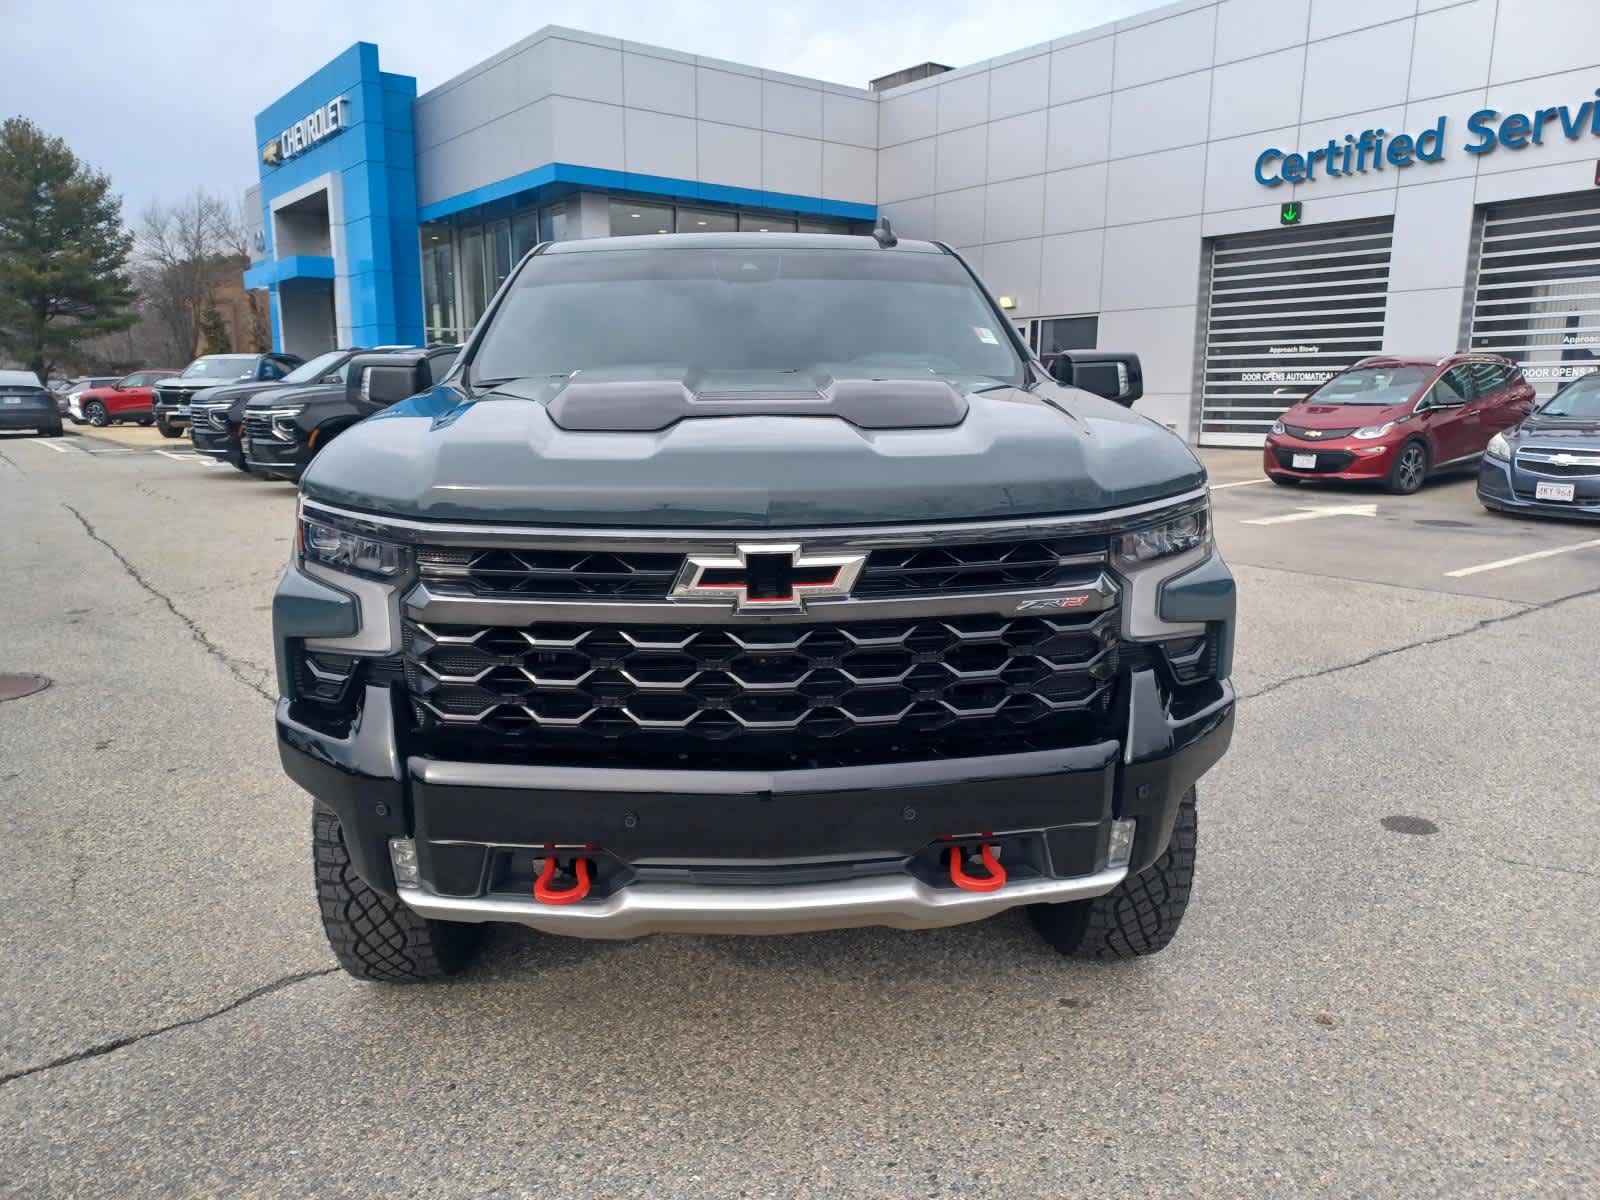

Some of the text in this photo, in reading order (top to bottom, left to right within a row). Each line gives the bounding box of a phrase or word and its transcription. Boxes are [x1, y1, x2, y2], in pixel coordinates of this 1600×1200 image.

[281, 96, 344, 158] CHEVROLET
[1254, 116, 1447, 185] Certified
[1269, 346, 1298, 354] Approach
[1241, 372, 1261, 381] DOOR
[1262, 372, 1285, 381] OPENS
[1522, 367, 1550, 378] DOOR
[1551, 367, 1586, 377] OPENS
[1016, 595, 1088, 611] ZR2
